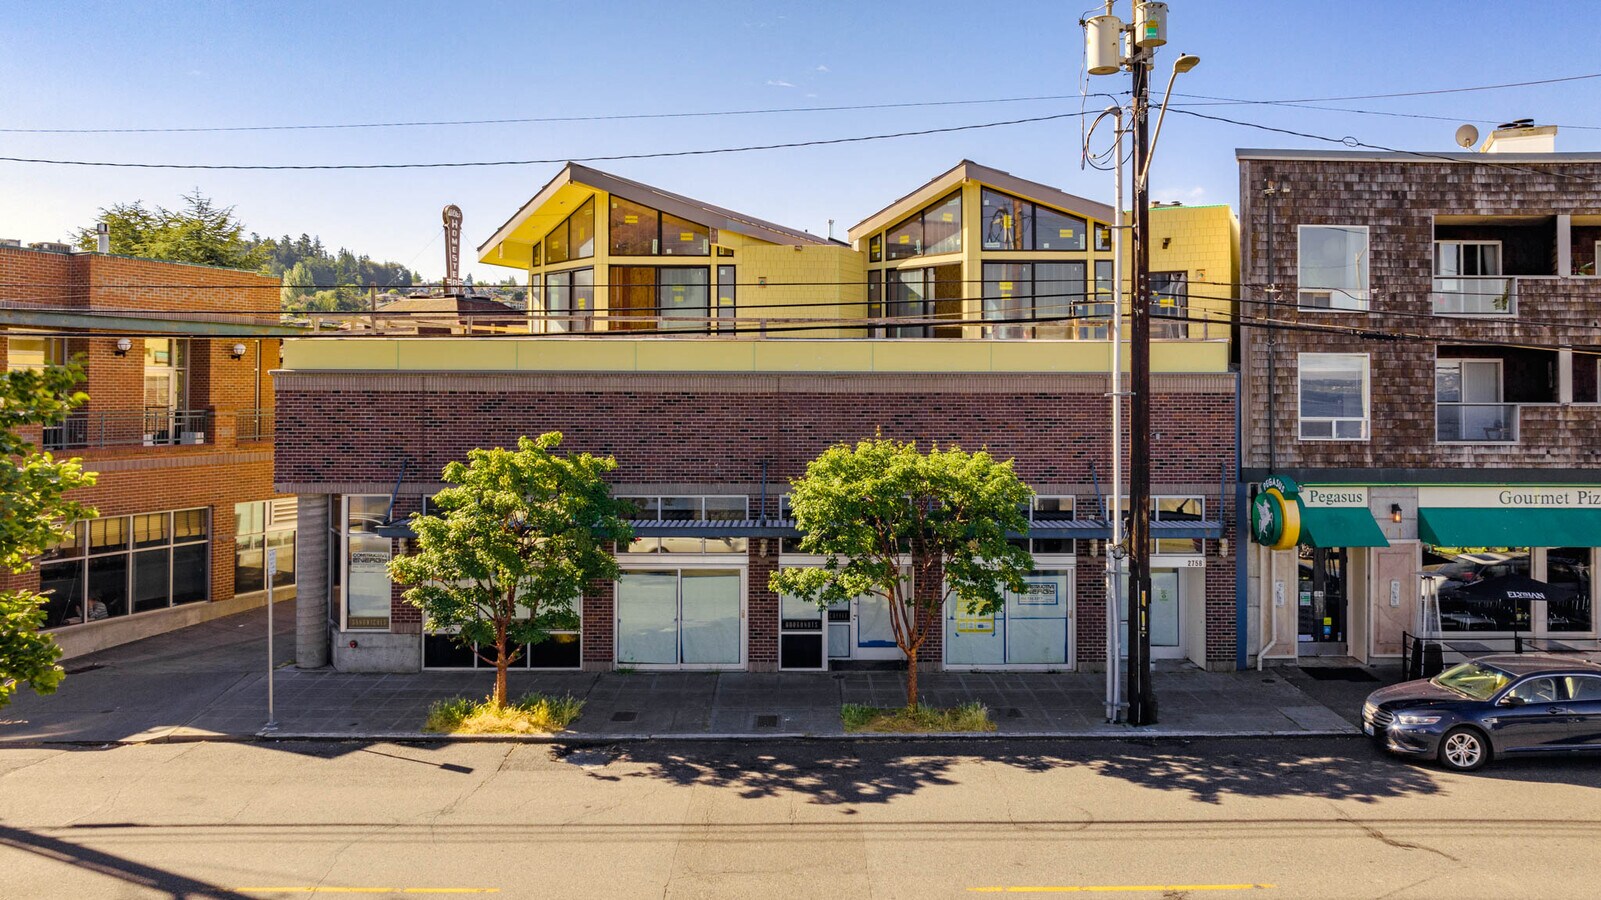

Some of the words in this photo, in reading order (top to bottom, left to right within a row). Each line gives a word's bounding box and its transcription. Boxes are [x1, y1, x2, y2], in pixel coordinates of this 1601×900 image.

[1263, 477, 1286, 494] PEGASUS
[1309, 490, 1363, 505] Pegasus
[1499, 490, 1570, 505] Gourmet
[1577, 490, 1601, 505] Piz
